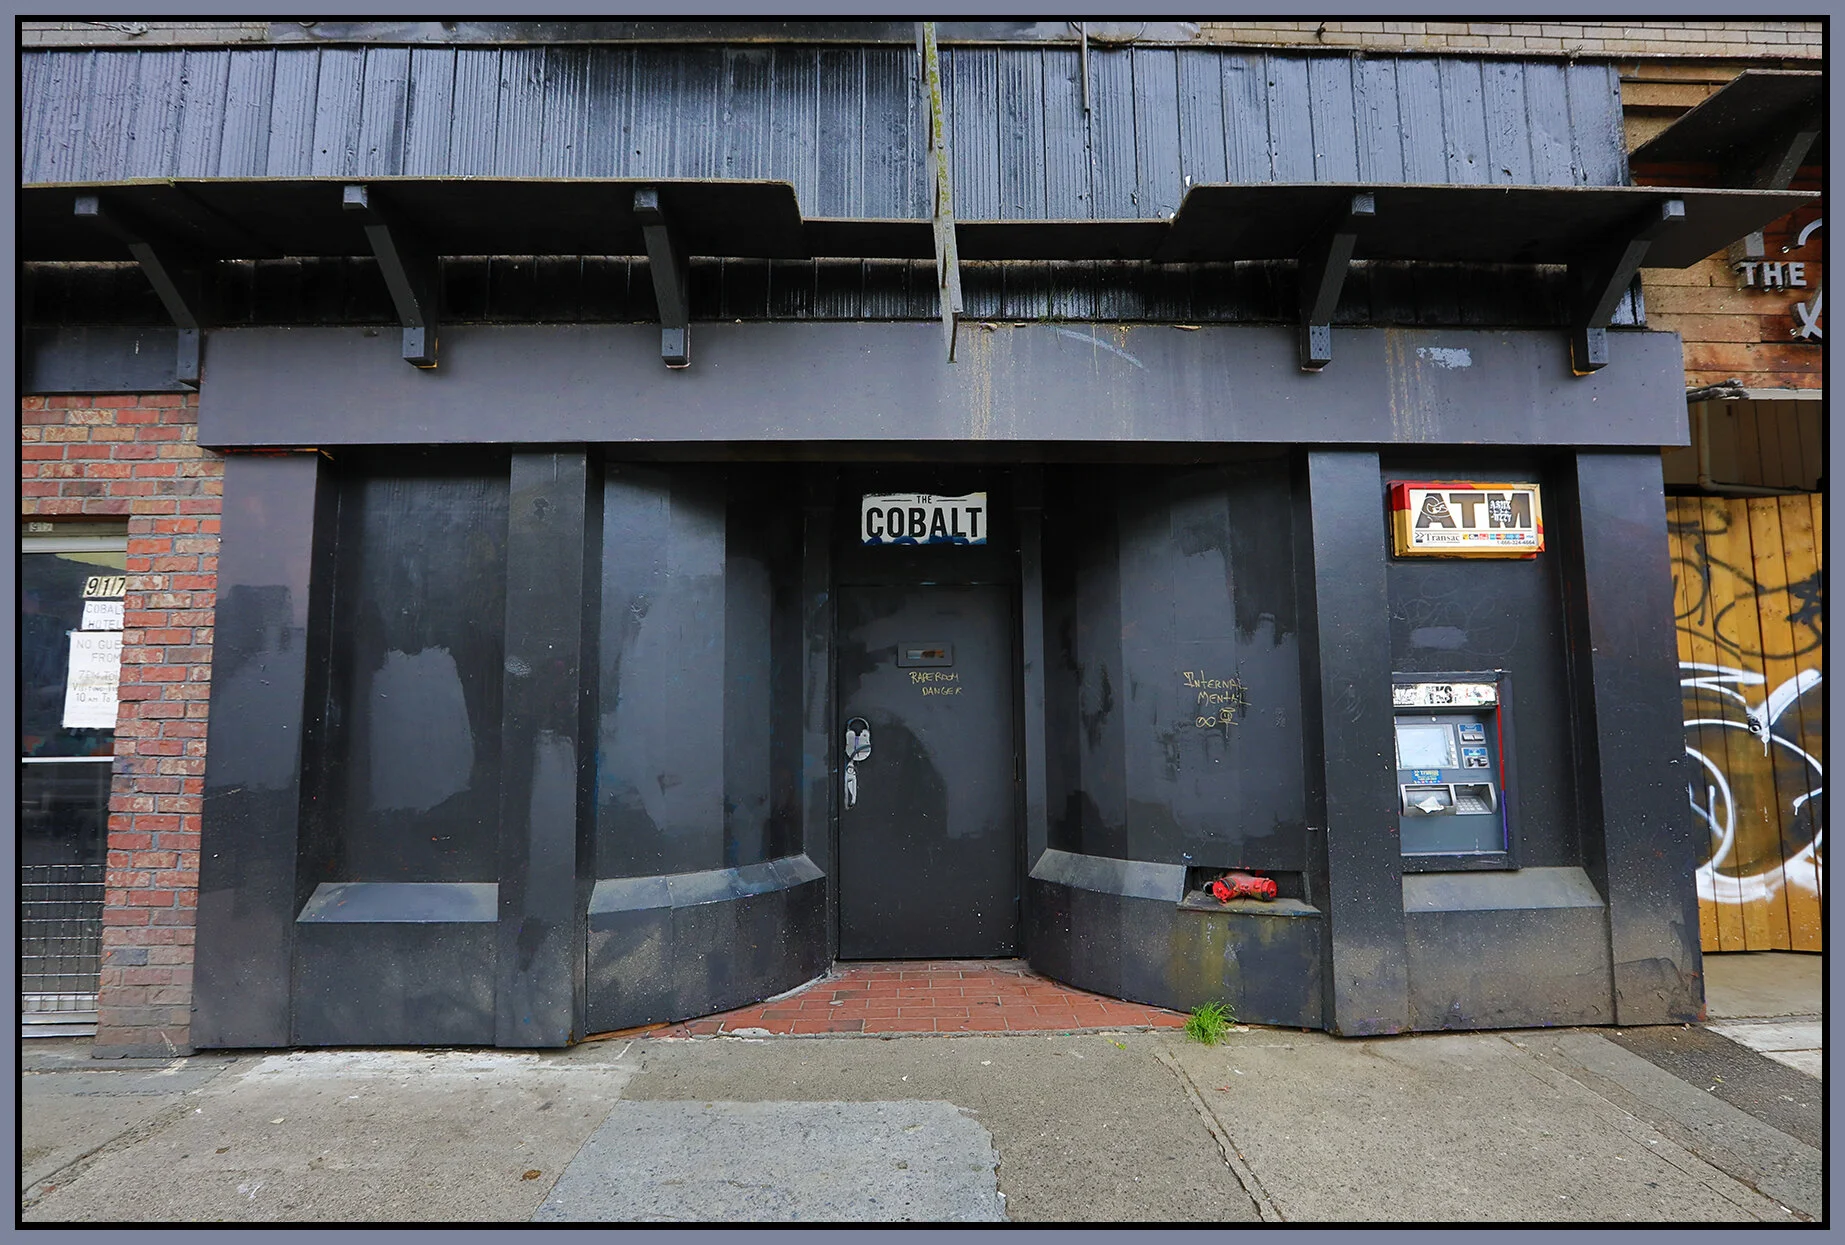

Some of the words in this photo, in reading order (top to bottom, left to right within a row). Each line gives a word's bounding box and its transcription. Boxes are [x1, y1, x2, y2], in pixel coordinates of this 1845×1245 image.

[1739, 262, 1807, 287] THE
[916, 495, 932, 504] THE
[1415, 493, 1532, 528] ATM
[866, 507, 983, 538] COBALT
[1424, 532, 1461, 541] Transac
[86, 577, 126, 596] 917
[87, 619, 123, 630] HOTEL
[76, 639, 92, 649] NO
[76, 692, 86, 702] 10
